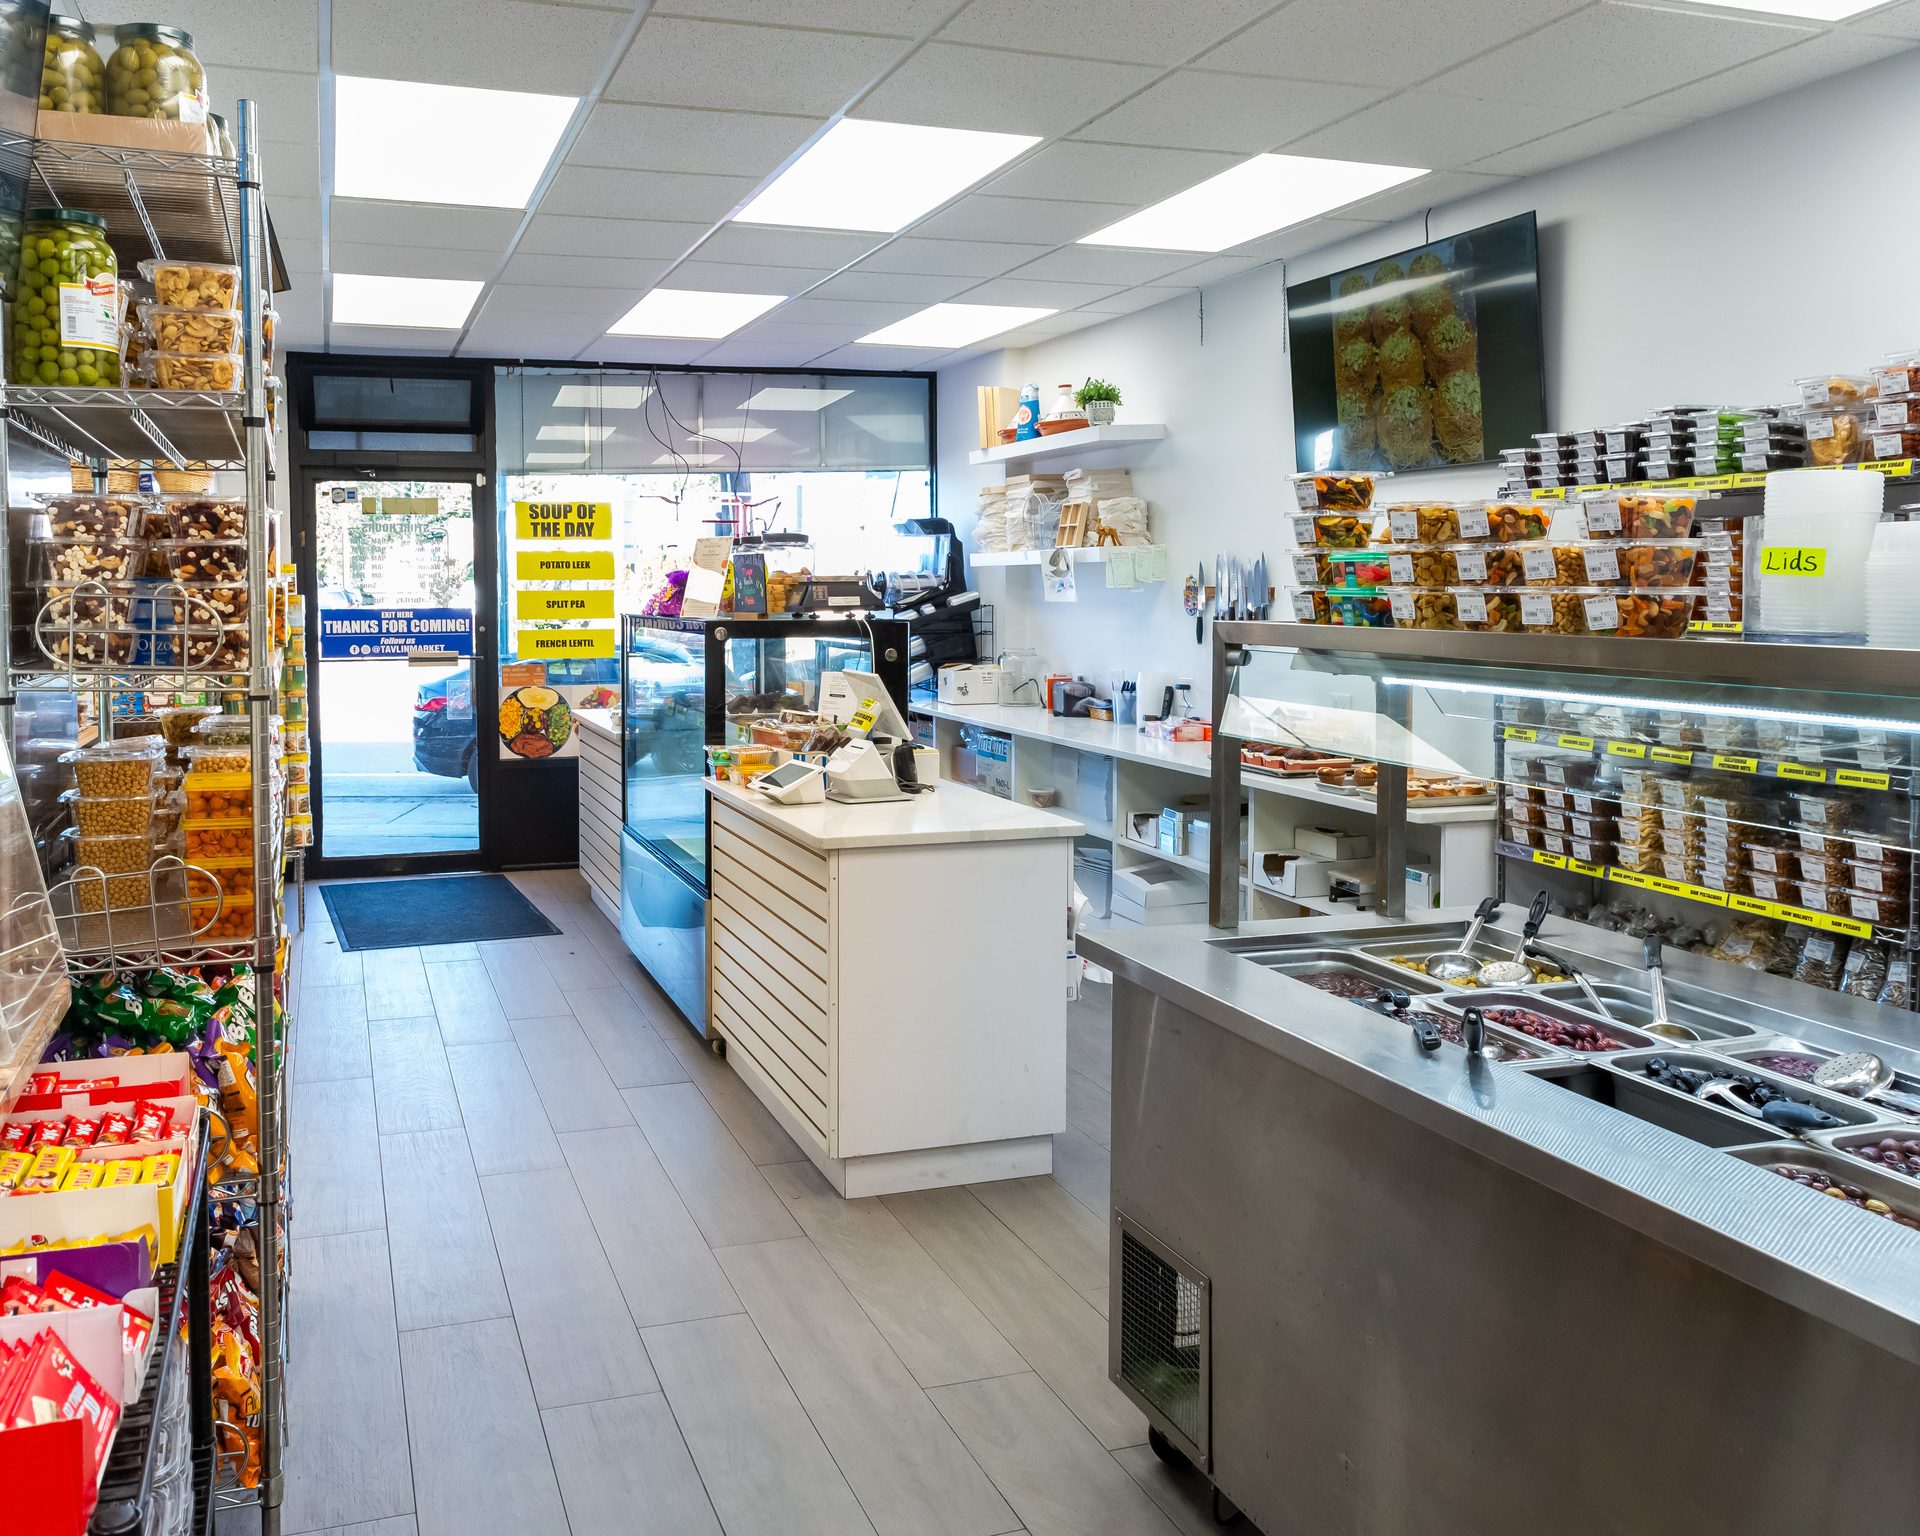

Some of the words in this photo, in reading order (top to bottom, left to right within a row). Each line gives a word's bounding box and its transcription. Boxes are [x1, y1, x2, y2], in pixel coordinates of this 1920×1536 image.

[529, 504, 573, 520] SOUP
[577, 504, 596, 519] OF
[530, 522, 560, 537] THE
[565, 522, 595, 537] DAY
[540, 561, 571, 569] POTATO
[572, 561, 591, 569] LEEK
[1766, 550, 1818, 571] Lids
[546, 600, 569, 609] SPLIT
[570, 600, 586, 608] PEA
[324, 620, 379, 634] THANKS
[382, 620, 408, 633] FOR
[411, 619, 470, 632] COMING!
[138, 639, 172, 651] Ozo
[380, 637, 405, 645] Follow
[405, 637, 416, 645] us
[536, 640, 567, 648] FRENCH
[569, 639, 595, 648] LENTIL
[372, 644, 446, 654] @TAVLINMARKET
[1783, 767, 1804, 775] ALMONDS
[1805, 769, 1821, 777] SALTED
[1839, 774, 1862, 782] ALMONDS
[1863, 776, 1887, 785] UNSALTED
[1662, 883, 1680, 892] CASHEWS
[1747, 902, 1766, 911] ALMONDS
[1792, 912, 1813, 922] WALNUTS
[1831, 920, 1842, 928] RAW
[1843, 922, 1861, 932] PECANS
